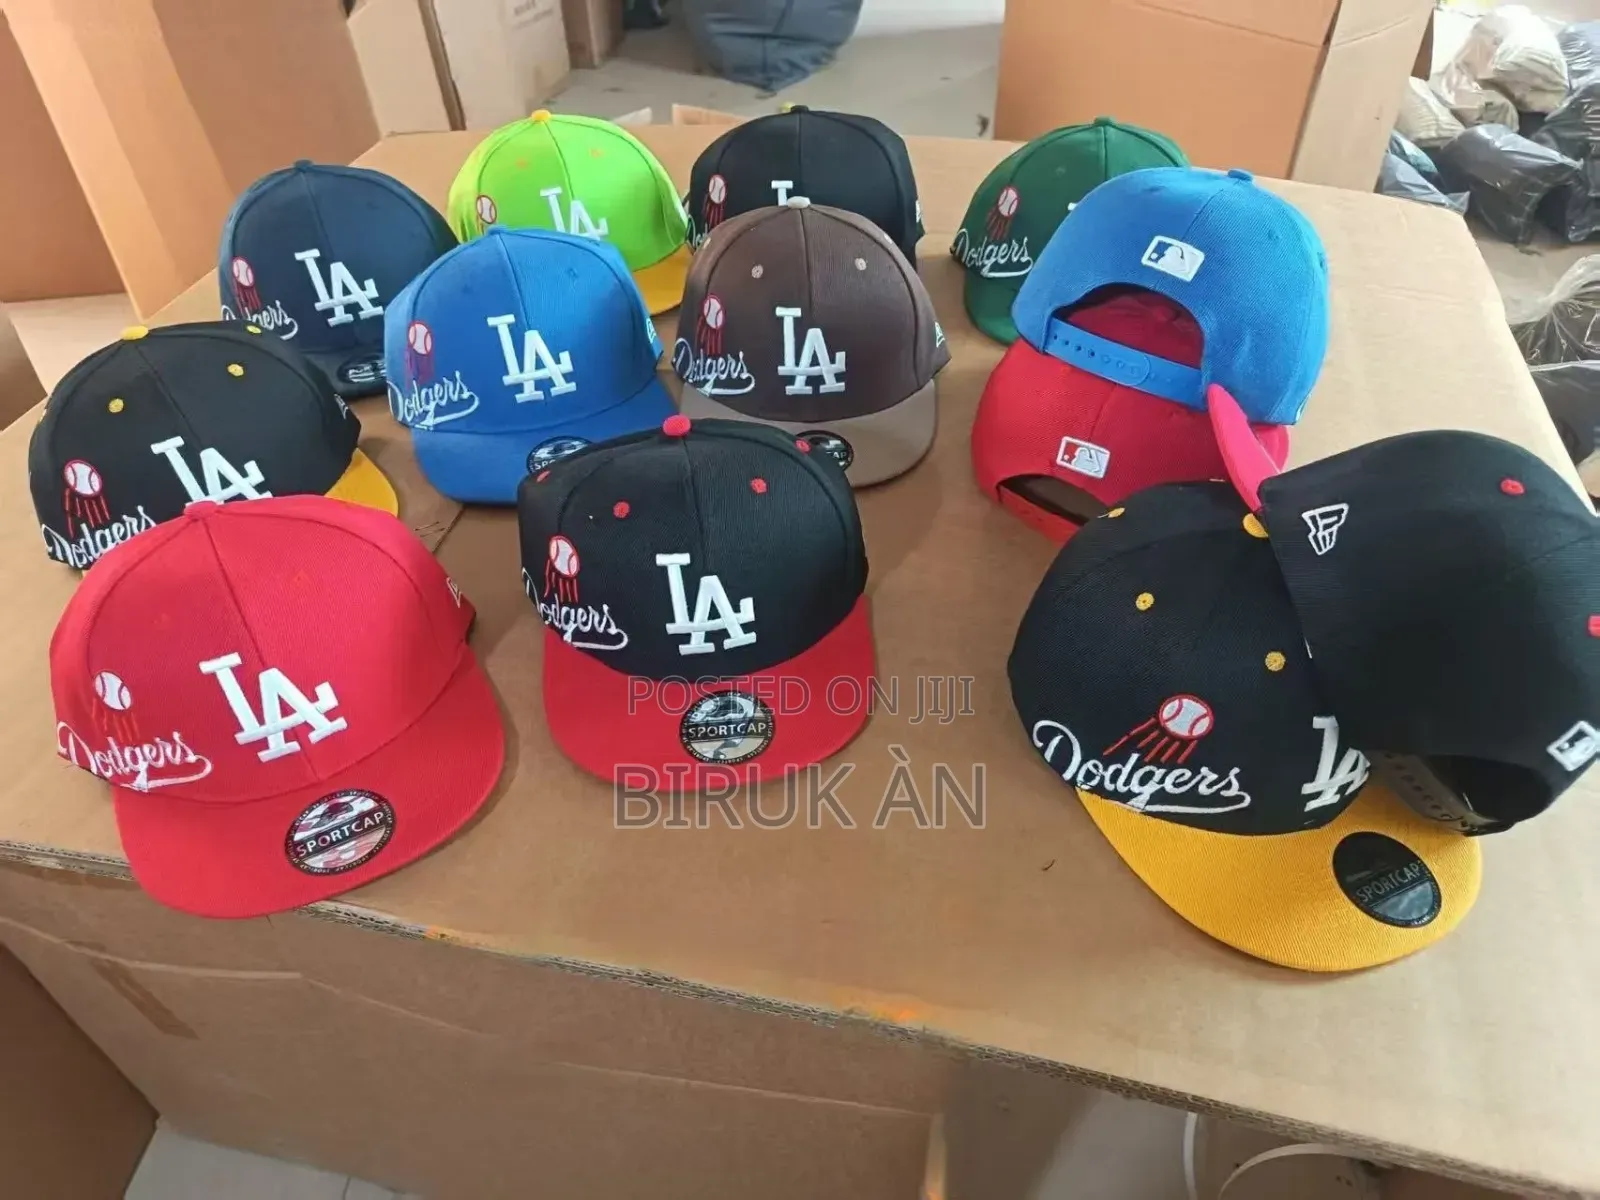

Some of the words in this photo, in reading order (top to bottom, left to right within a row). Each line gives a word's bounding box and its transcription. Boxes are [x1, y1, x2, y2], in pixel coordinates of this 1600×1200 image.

[294, 248, 384, 327] LA
[952, 228, 1034, 279] Dodgers
[487, 314, 577, 403] LA
[775, 306, 846, 395] LA
[387, 370, 479, 430] Dodgers
[150, 435, 273, 505] LA
[655, 552, 757, 656] LA
[199, 652, 348, 763] LA
[688, 722, 767, 738] SPORTCAP
[57, 721, 213, 793] Dodgers
[1032, 719, 1252, 815] Dodgers
[1301, 715, 1371, 812] LA
[296, 811, 384, 857] SPORTCAP
[1355, 861, 1421, 902] SPORTCAP
